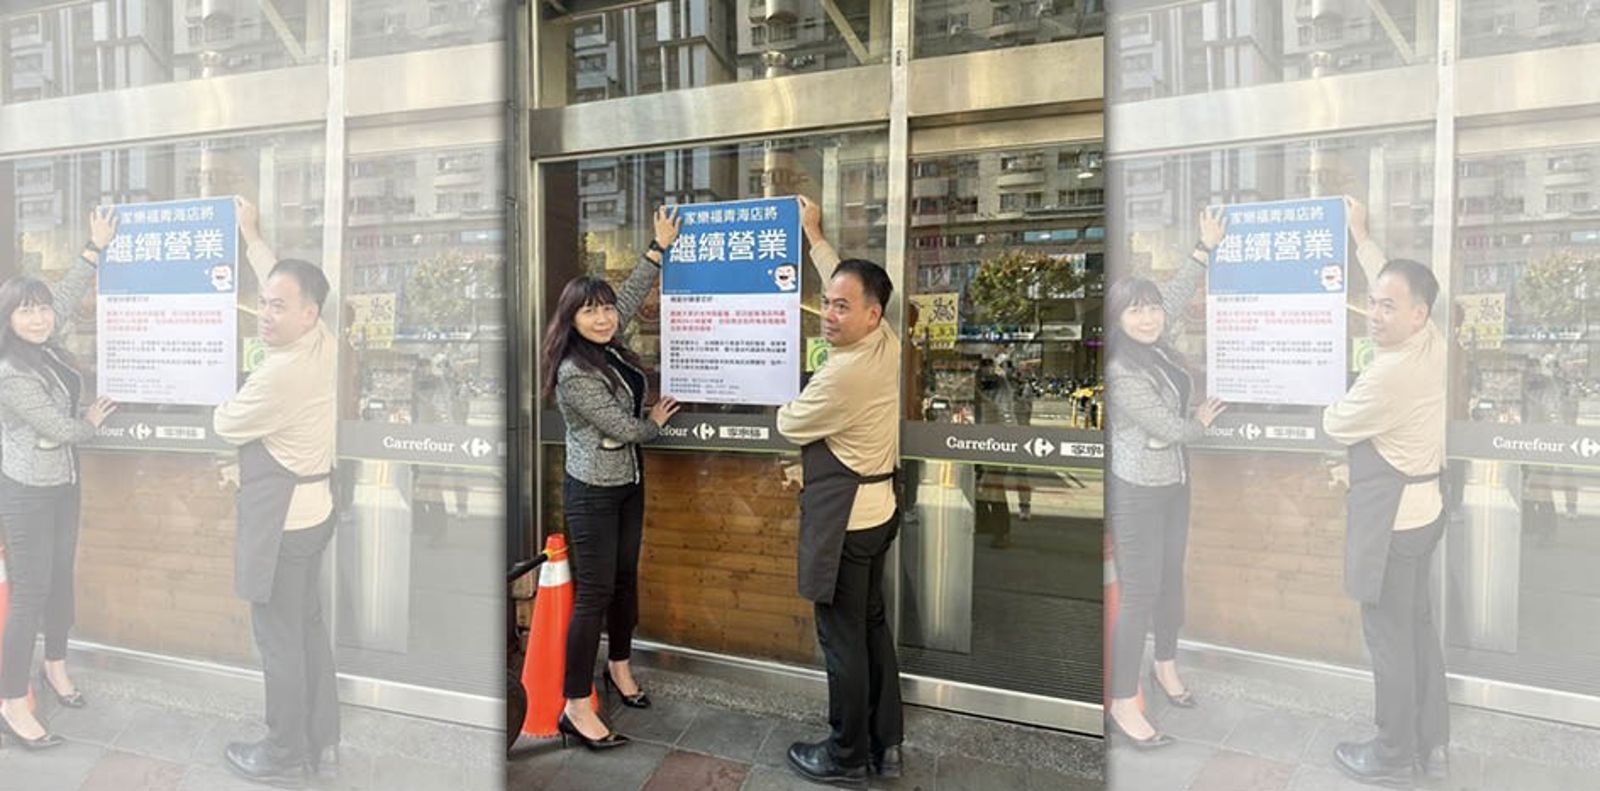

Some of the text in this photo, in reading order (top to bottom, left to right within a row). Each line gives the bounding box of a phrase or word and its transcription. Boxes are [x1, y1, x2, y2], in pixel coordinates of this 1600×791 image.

[106, 228, 225, 263] 繼續營業
[670, 228, 787, 263] 繼續營業
[1216, 228, 1334, 263] 繼續營業
[659, 425, 689, 437] efour
[383, 436, 455, 453] Carrefour
[946, 436, 1018, 453] Carrefour
[1492, 436, 1565, 453] Carrefour
